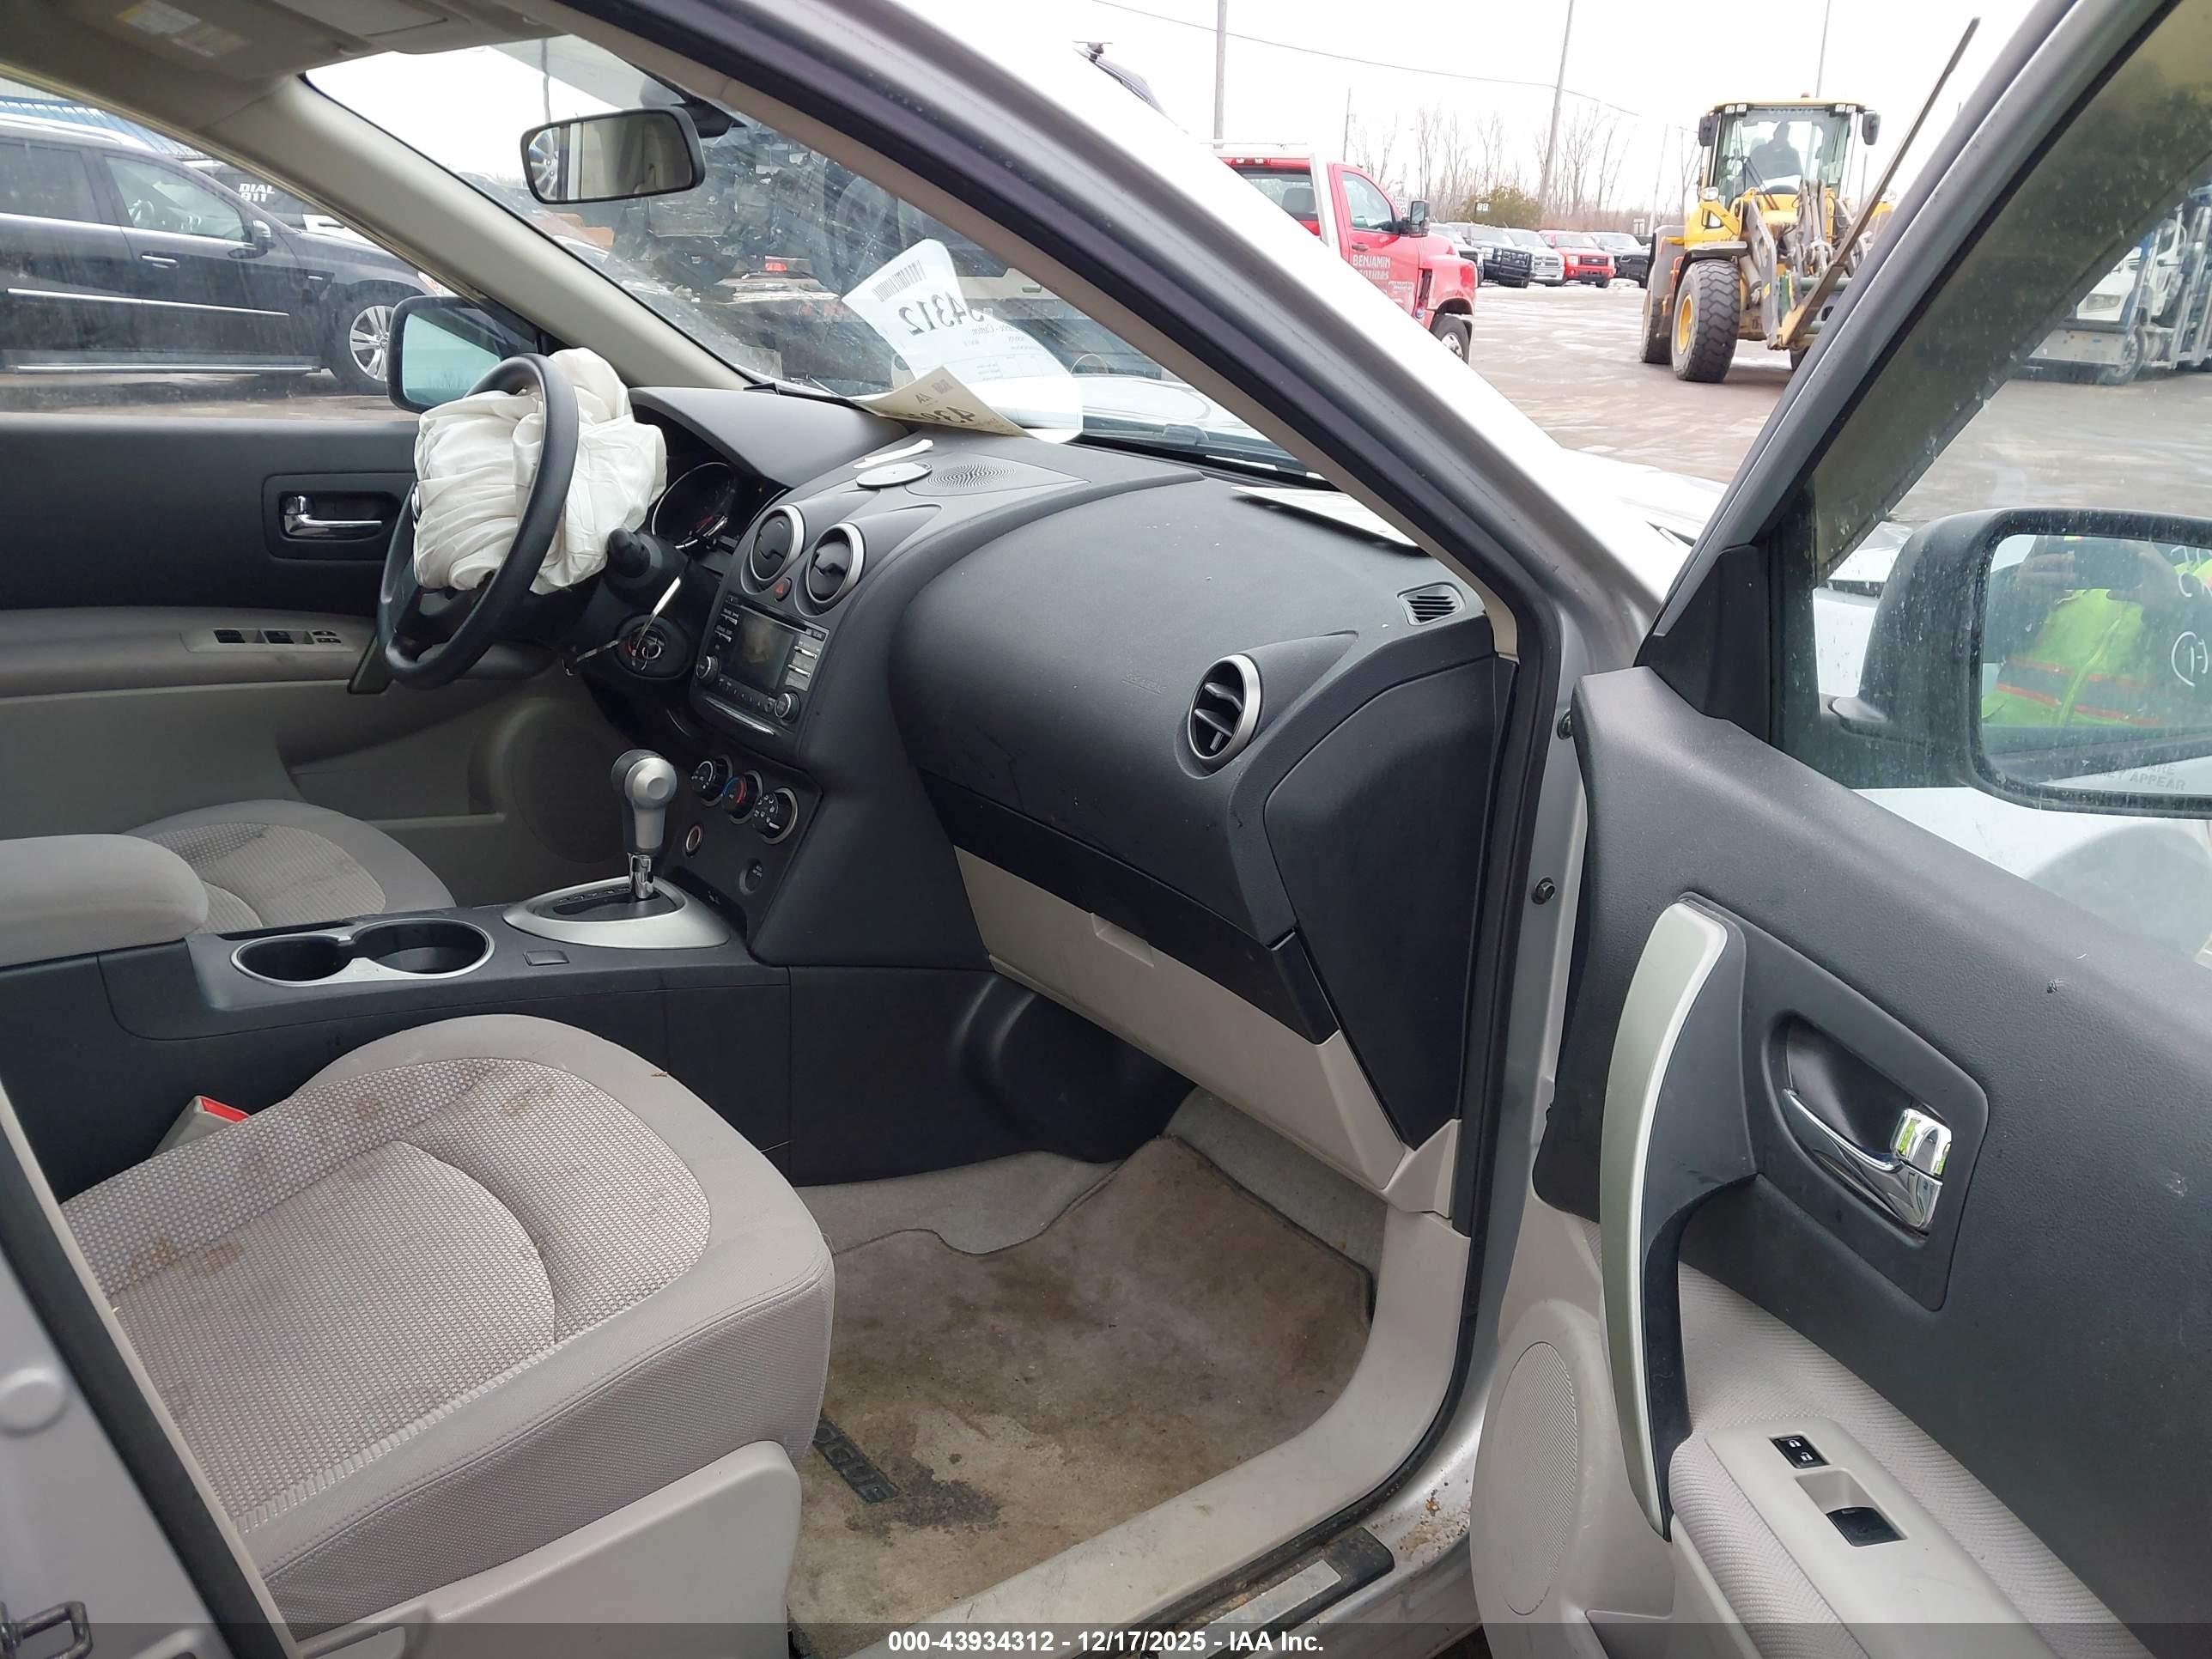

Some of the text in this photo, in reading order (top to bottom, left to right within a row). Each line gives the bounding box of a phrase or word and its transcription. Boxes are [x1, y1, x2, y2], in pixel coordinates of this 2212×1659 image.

[239, 183, 276, 194] DIAL
[240, 191, 267, 203] 911
[1352, 254, 1391, 269] BENJAMIN
[2130, 770, 2185, 790] APPEAR
